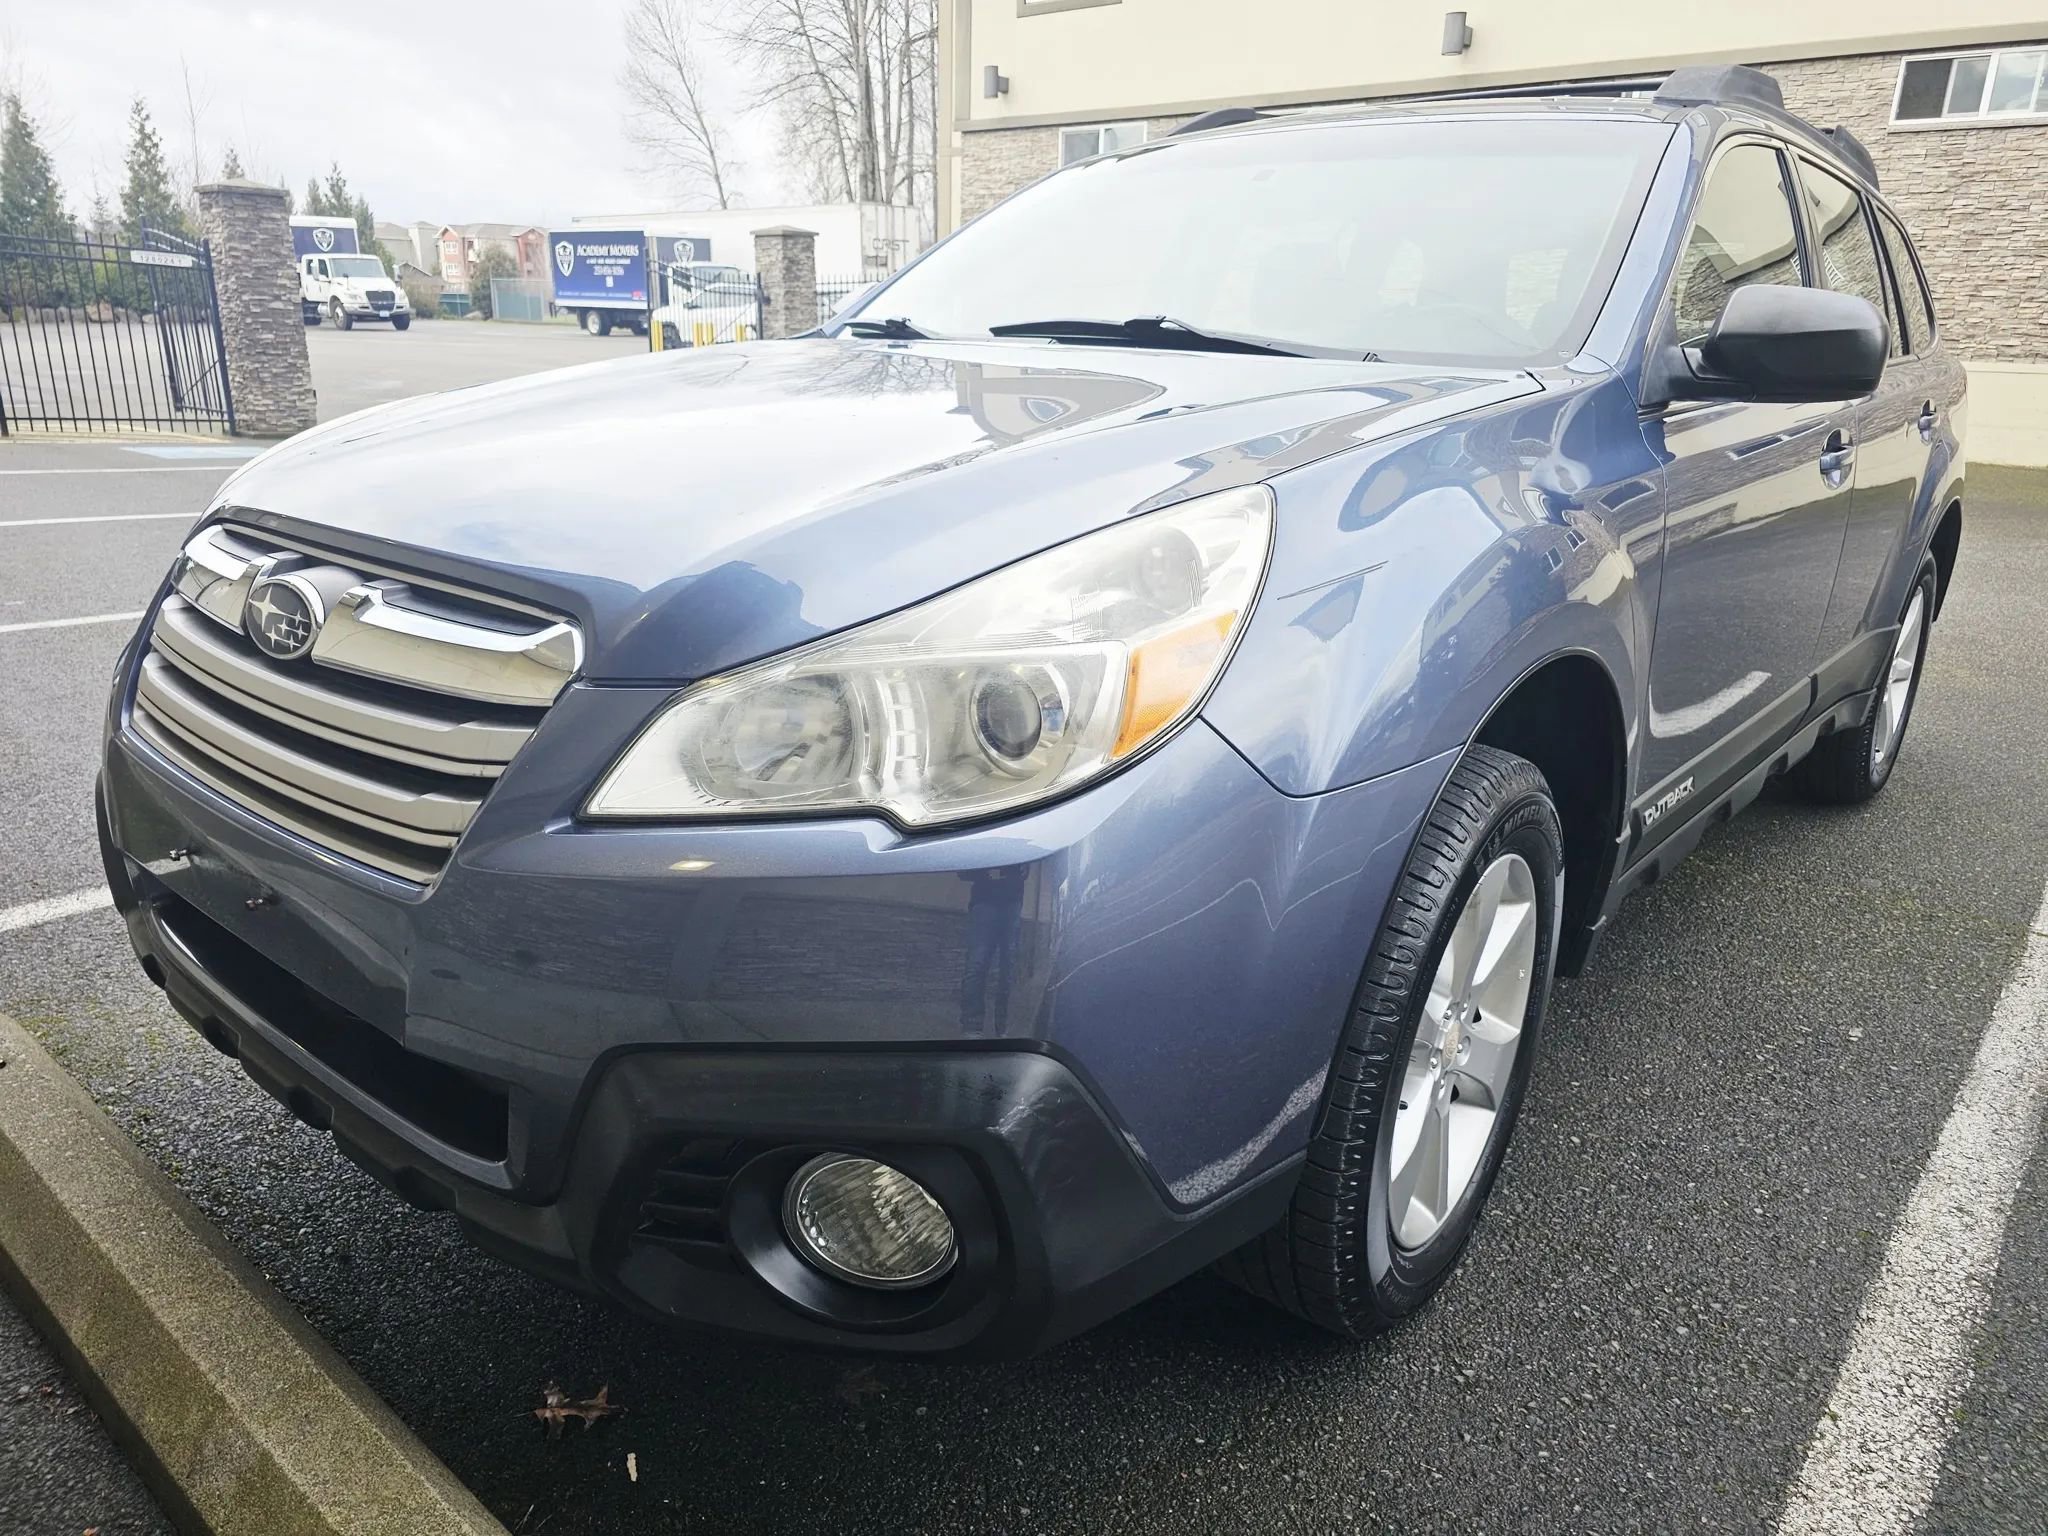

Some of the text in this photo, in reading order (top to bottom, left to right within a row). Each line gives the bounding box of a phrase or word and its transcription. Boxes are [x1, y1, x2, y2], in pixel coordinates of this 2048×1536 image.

[576, 244, 639, 257] ACADEMY MOVERS
[1643, 776, 1695, 826] OUTBACK
